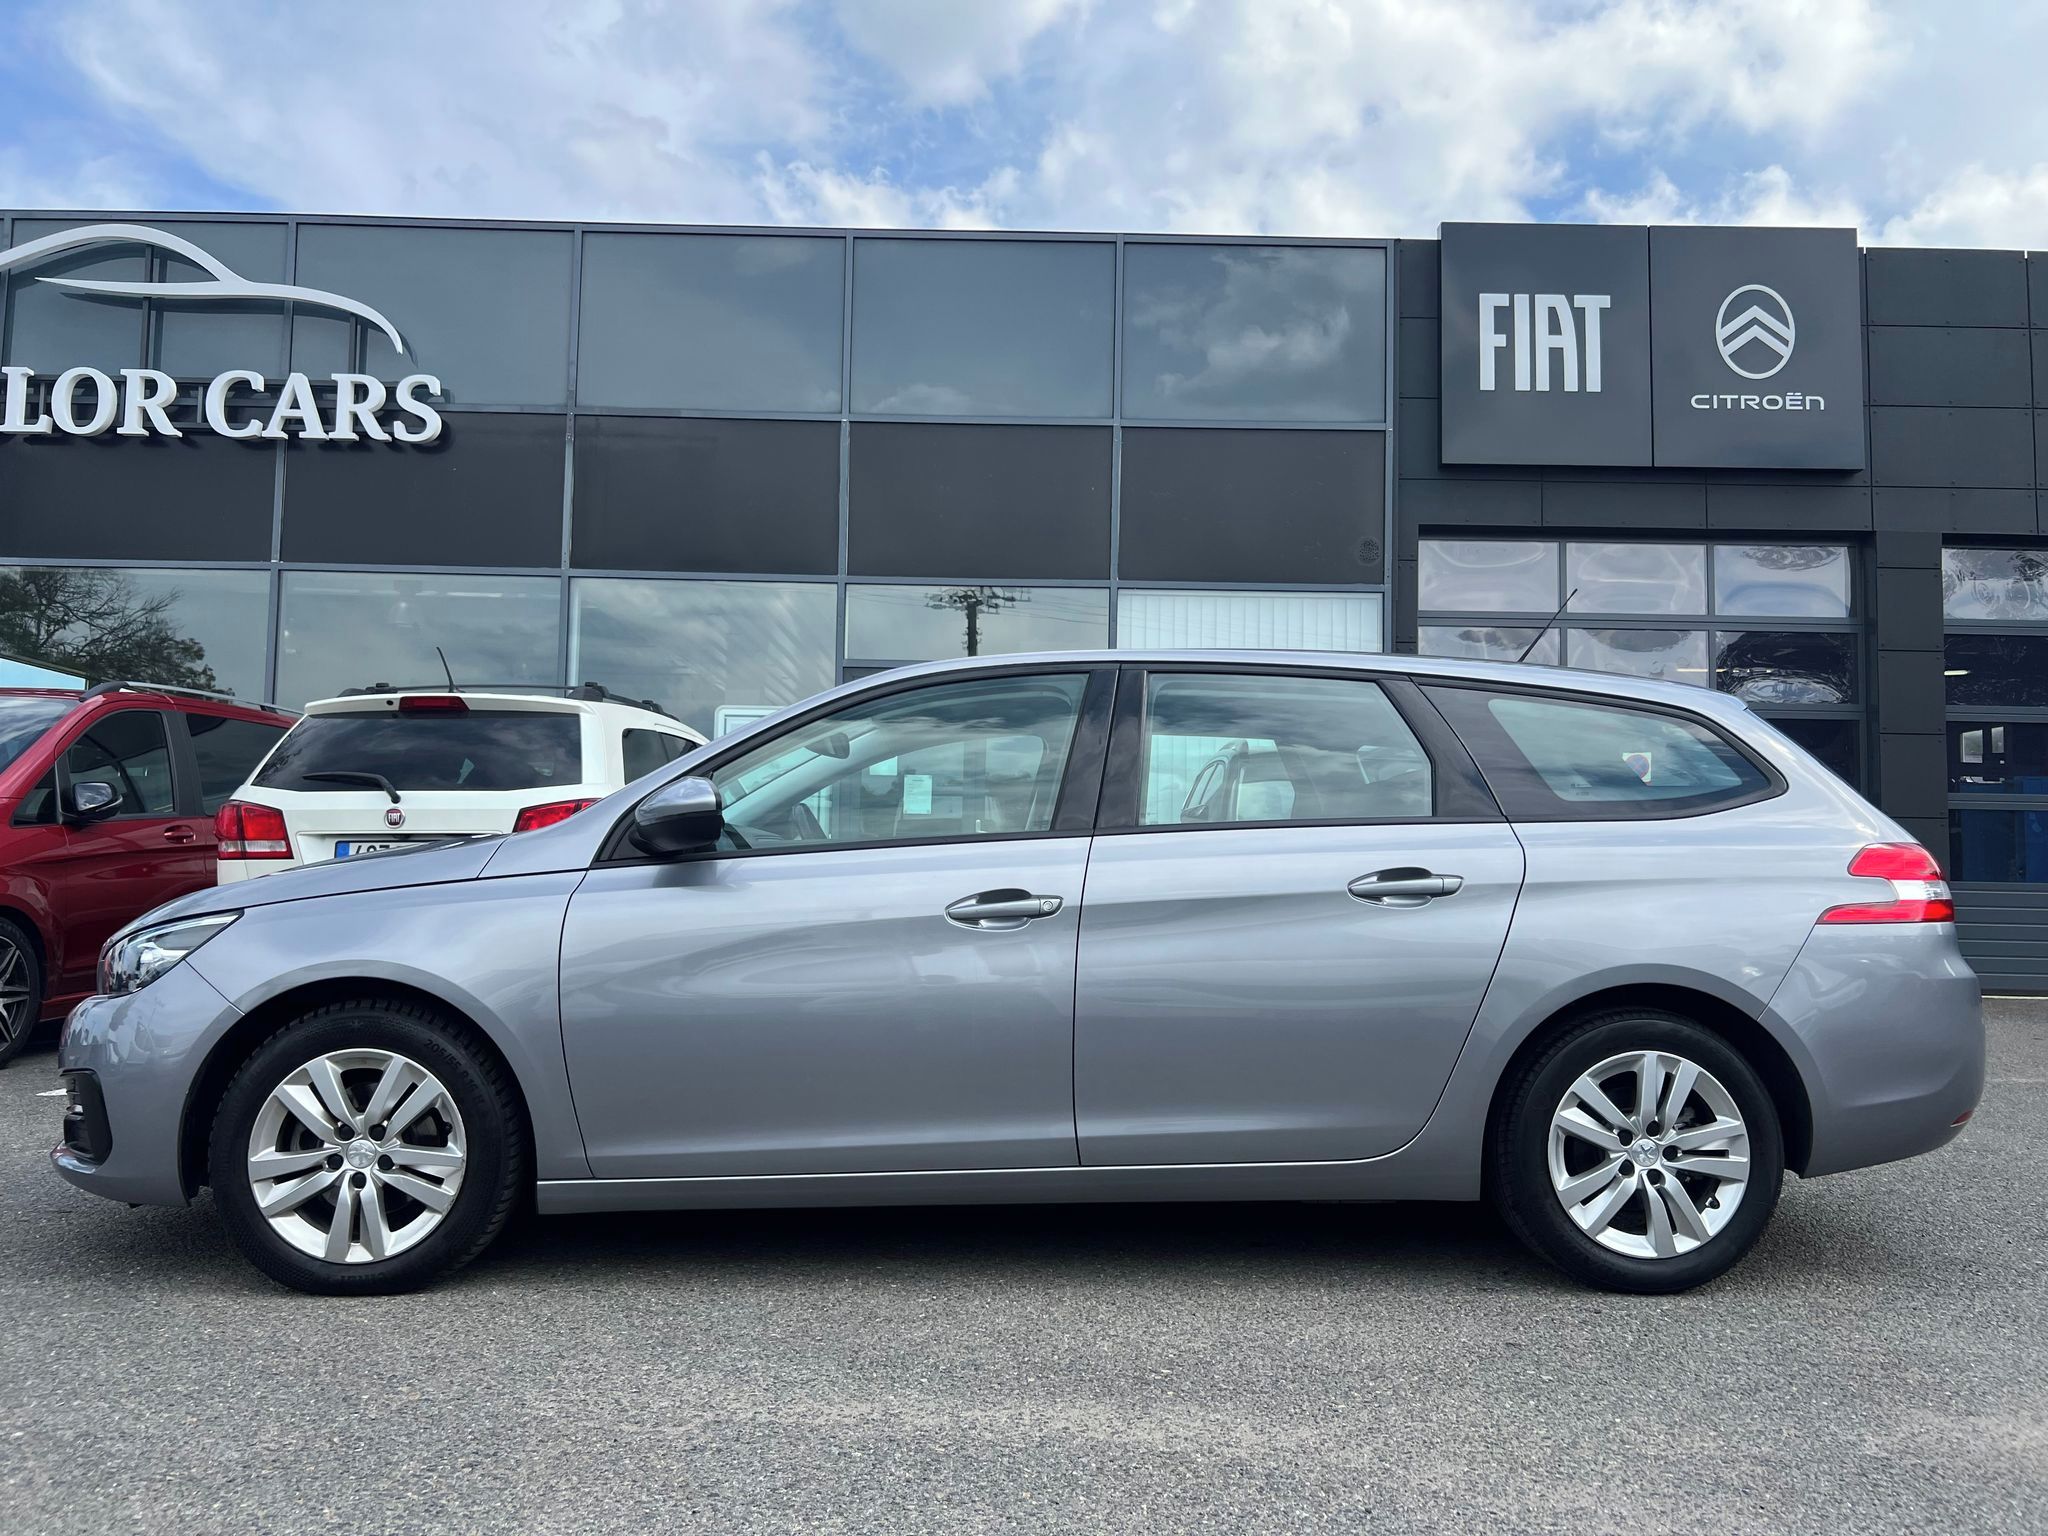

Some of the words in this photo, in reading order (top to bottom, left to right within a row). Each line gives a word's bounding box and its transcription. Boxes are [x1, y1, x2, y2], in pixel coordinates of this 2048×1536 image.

[1479, 293, 1611, 392] FIAT
[205, 370, 443, 443] CARS
[388, 812, 401, 823] FIAT
